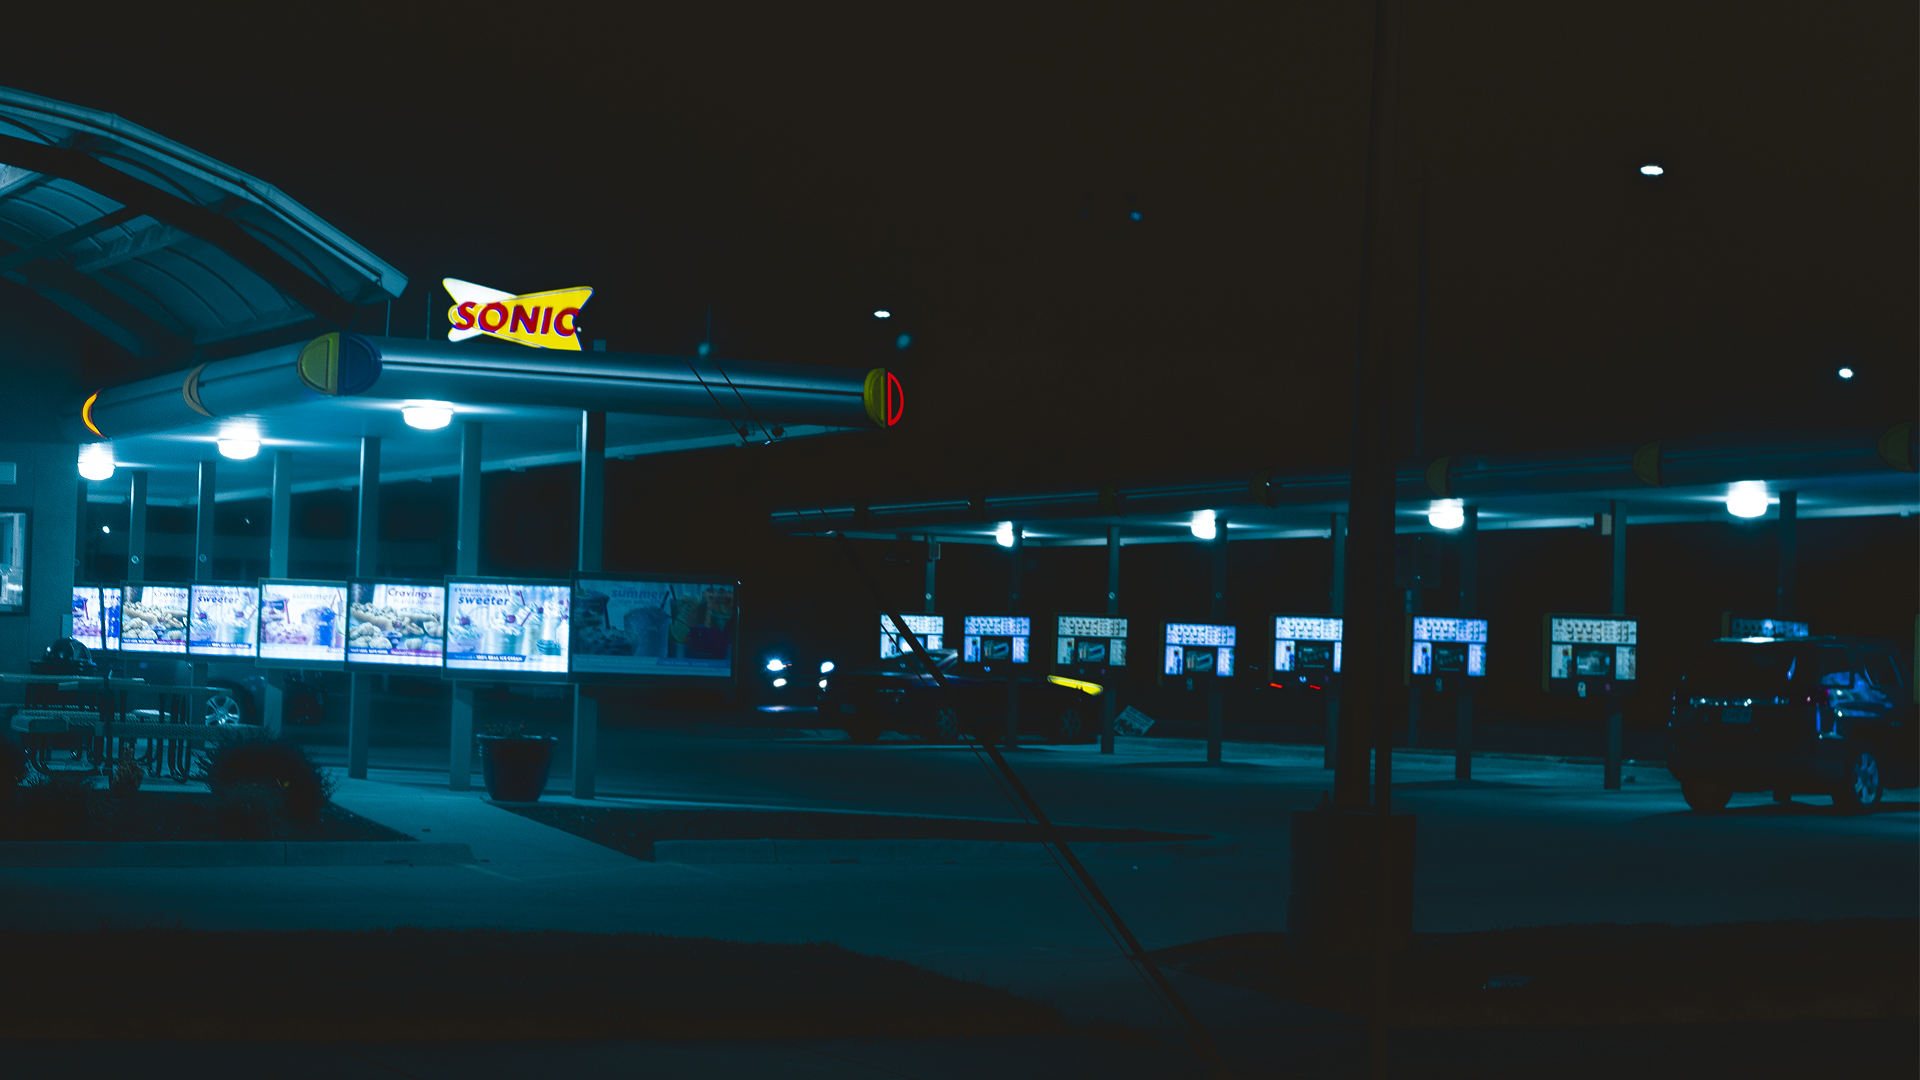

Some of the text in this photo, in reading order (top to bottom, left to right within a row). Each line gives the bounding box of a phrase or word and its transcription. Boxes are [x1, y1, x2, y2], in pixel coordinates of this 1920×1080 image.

[452, 301, 580, 337] SONIC
[388, 587, 432, 600] Cravings
[458, 596, 510, 606] sweeter
